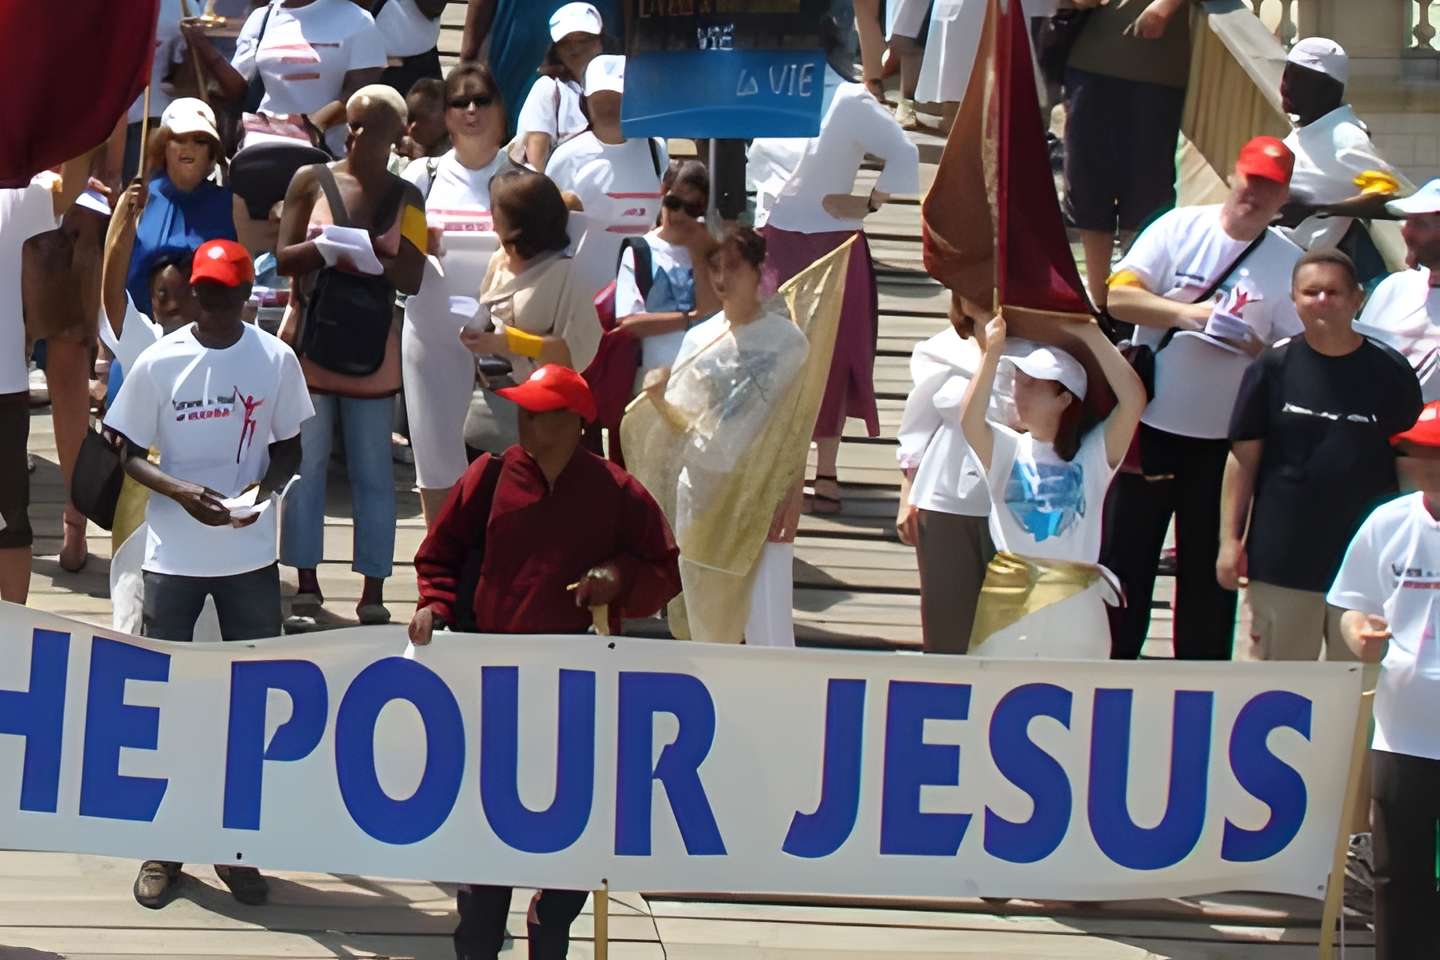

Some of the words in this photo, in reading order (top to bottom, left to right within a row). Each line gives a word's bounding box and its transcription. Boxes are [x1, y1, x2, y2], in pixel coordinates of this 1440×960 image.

[768, 63, 815, 97] VIE
[222, 656, 727, 856] POUR
[782, 681, 1313, 869] JESUS
